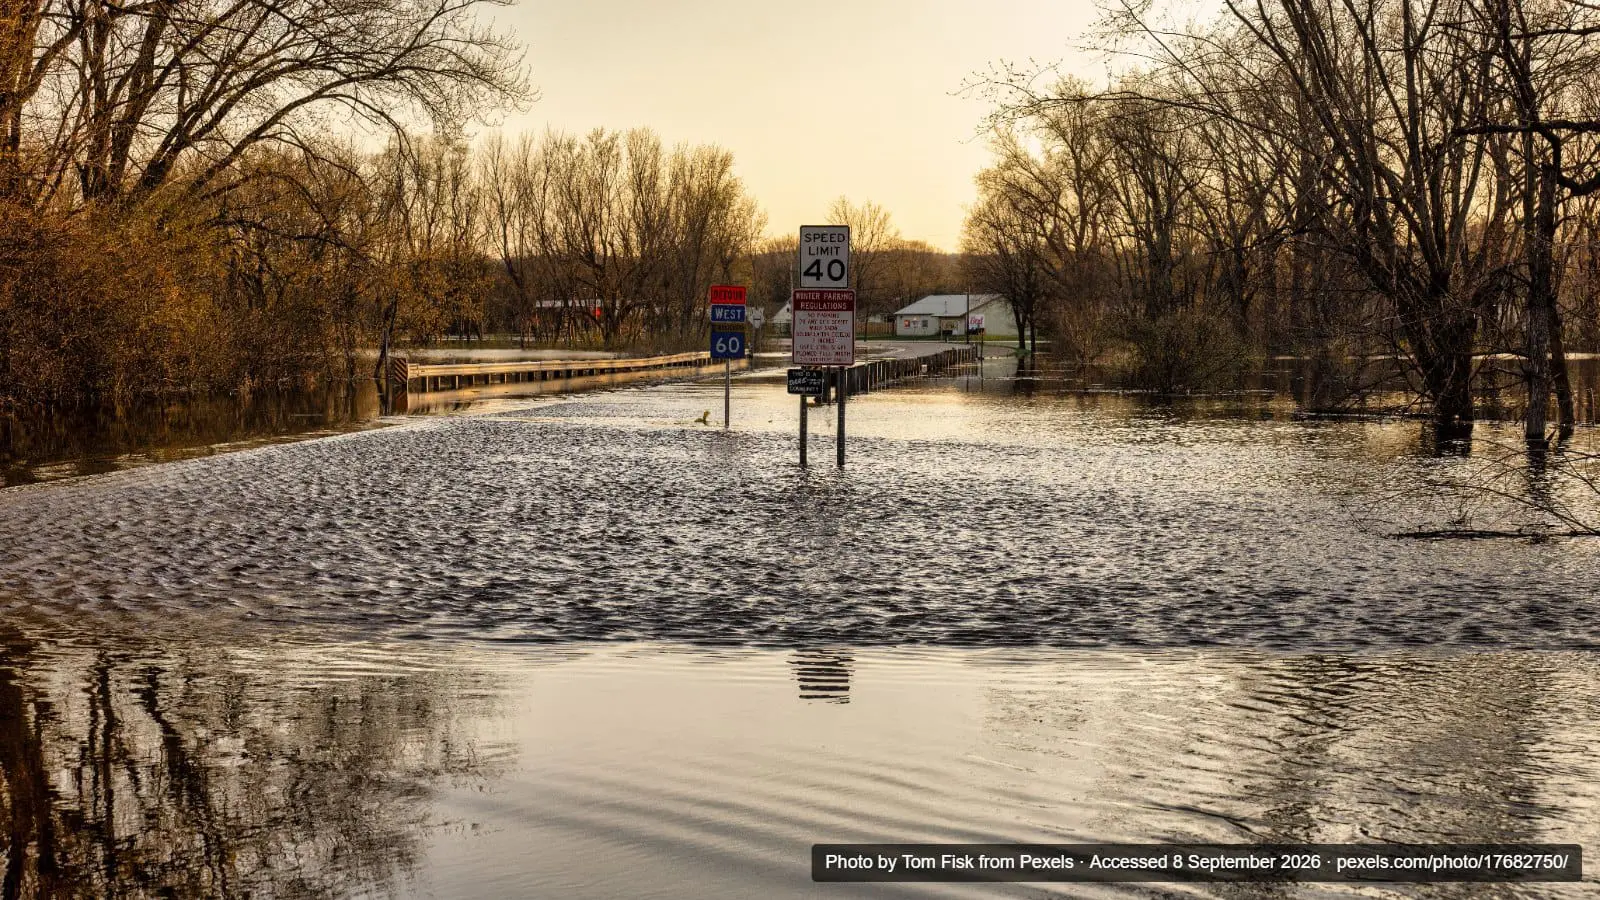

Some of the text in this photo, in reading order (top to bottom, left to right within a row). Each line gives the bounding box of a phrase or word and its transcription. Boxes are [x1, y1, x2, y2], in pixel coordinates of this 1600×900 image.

[804, 233, 845, 243] SPEED
[809, 246, 840, 256] LIMIT
[803, 259, 845, 281] 40
[795, 292, 853, 301] WINTER PARKING
[800, 302, 847, 310] REGULATIONS
[715, 308, 742, 320] WEST
[715, 336, 740, 353] 60
